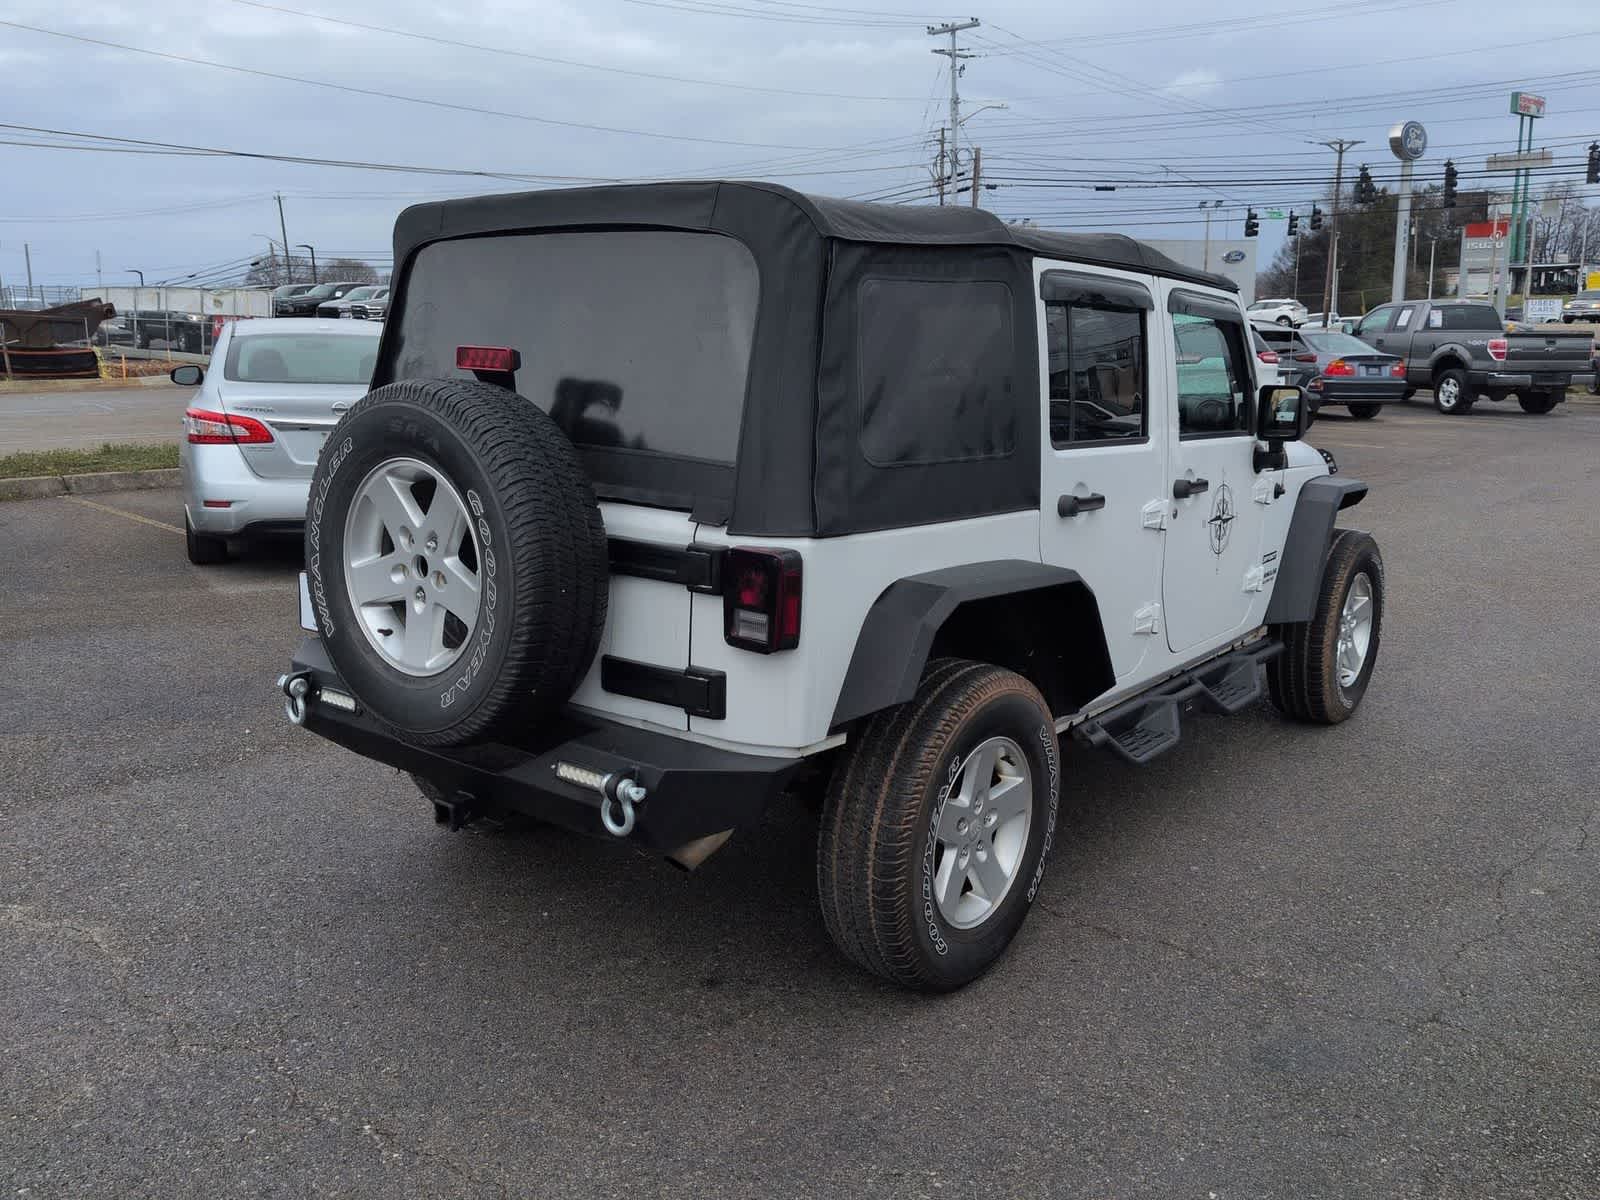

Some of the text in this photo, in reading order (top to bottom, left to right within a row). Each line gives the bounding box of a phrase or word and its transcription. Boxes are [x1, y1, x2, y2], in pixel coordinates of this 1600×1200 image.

[1466, 241, 1504, 249] ISUZU
[310, 436, 353, 638] WRANGLER
[440, 489, 497, 709] GOODYEAR
